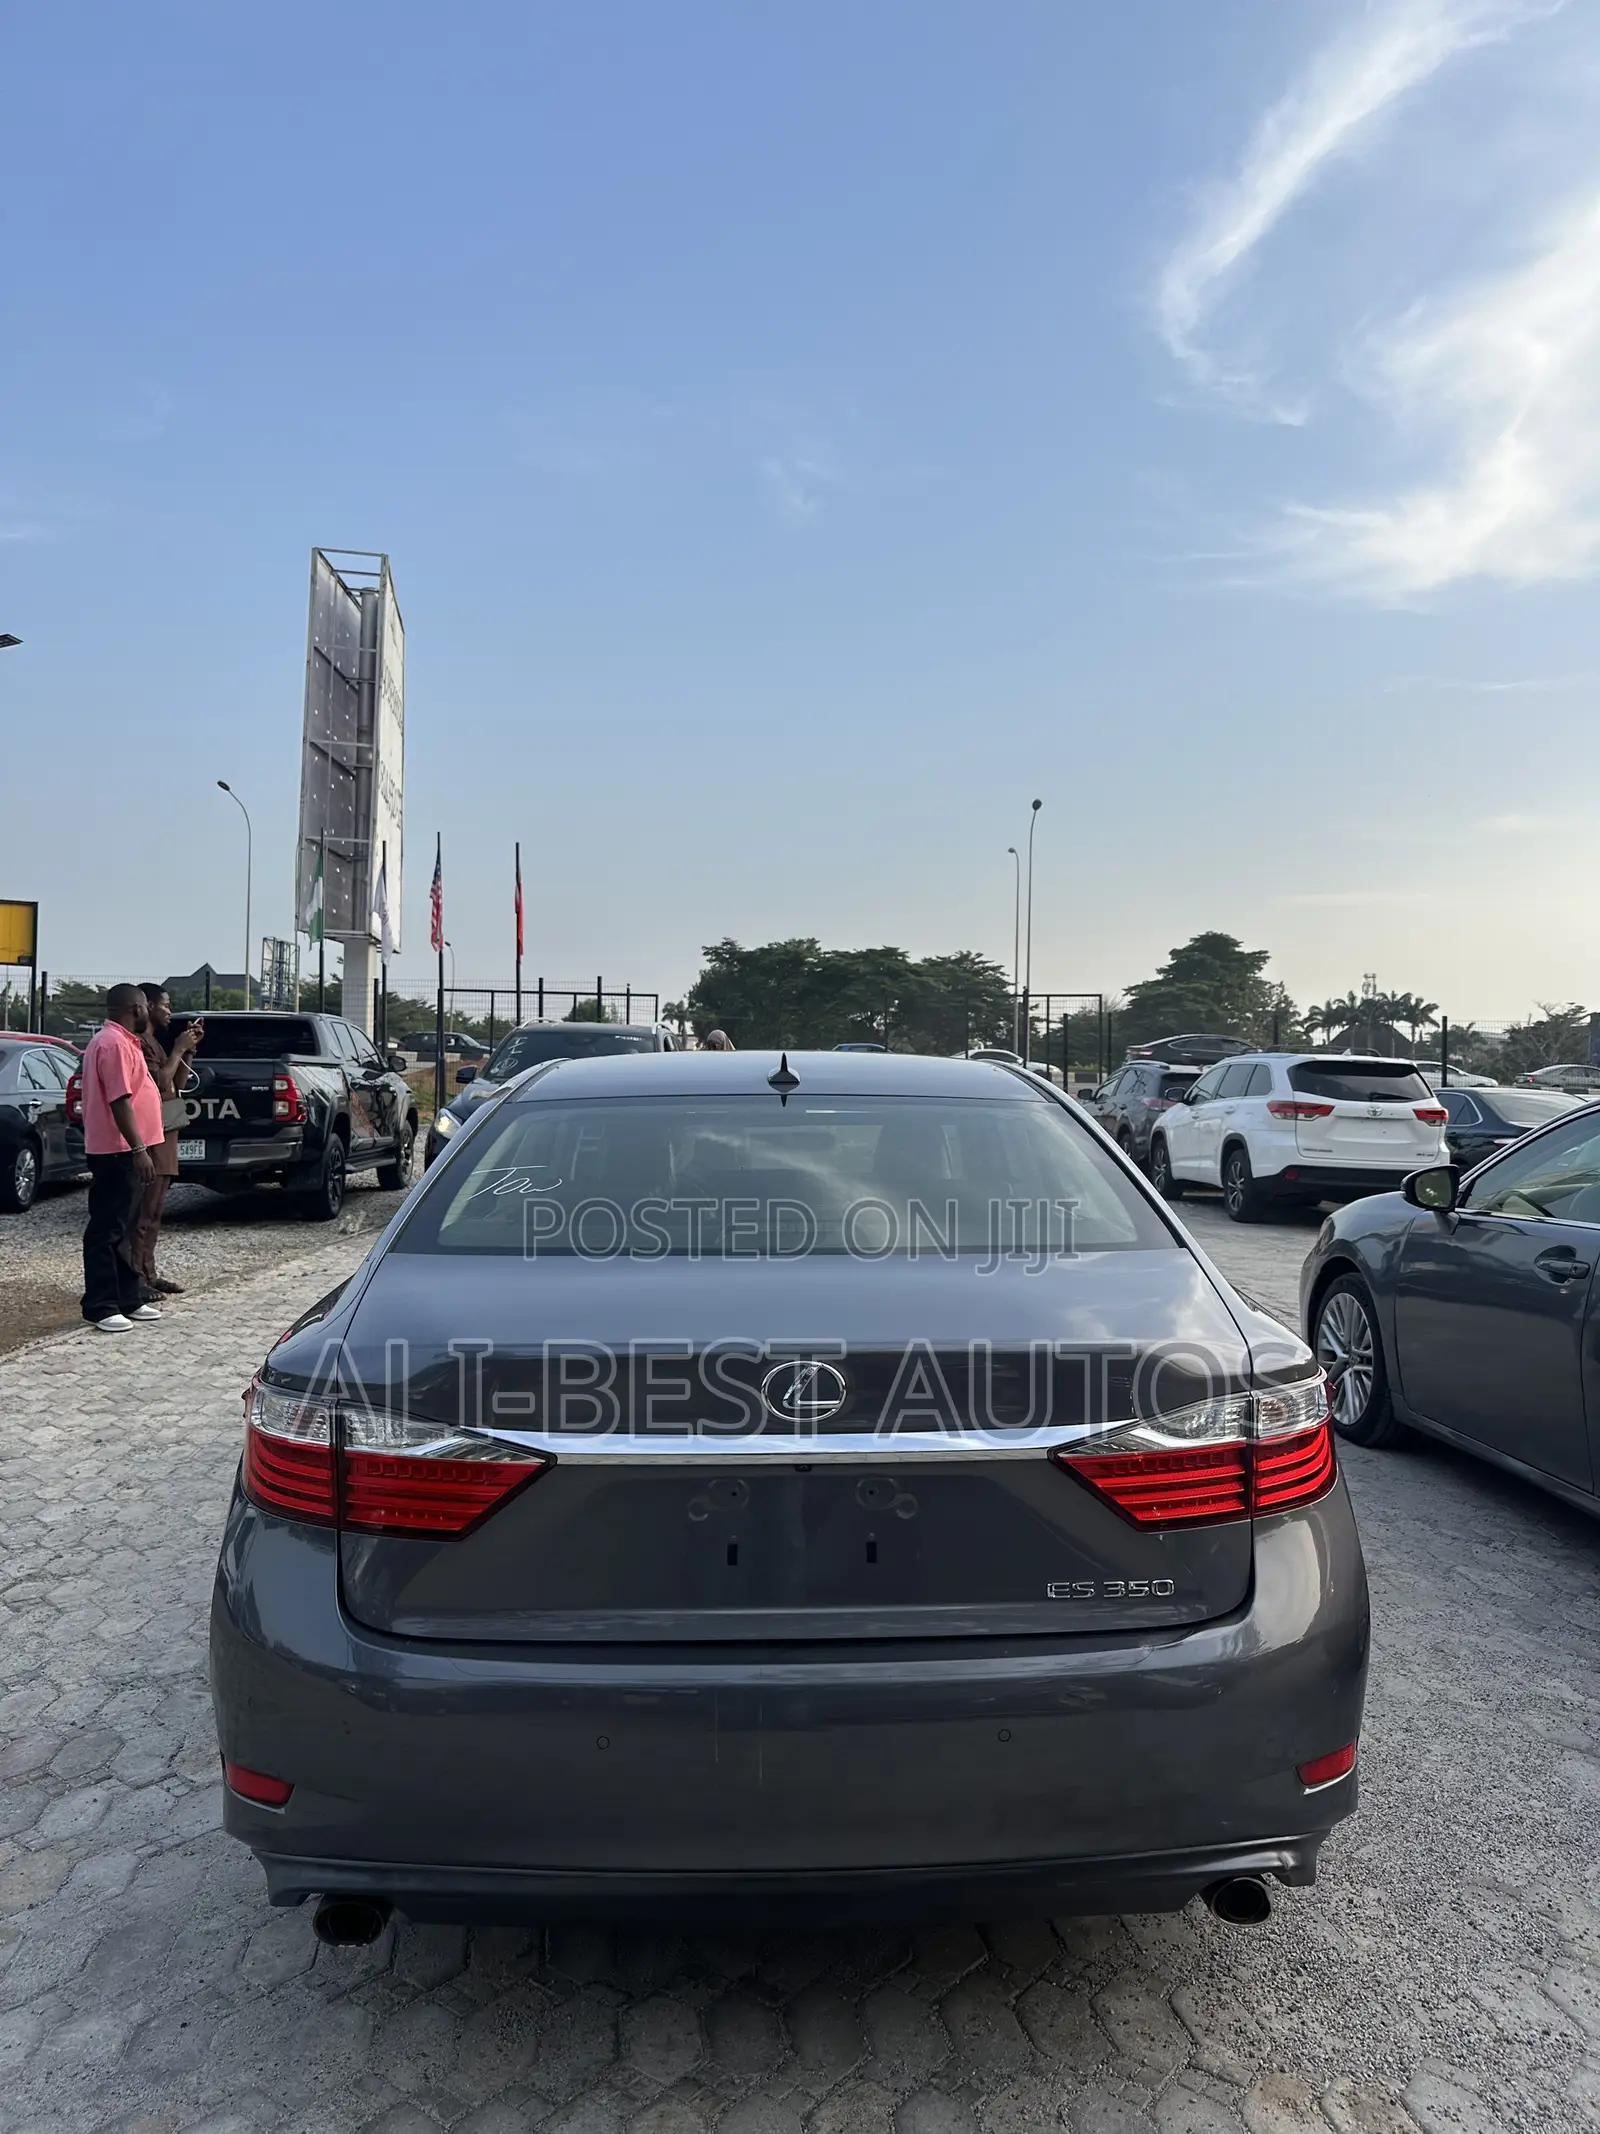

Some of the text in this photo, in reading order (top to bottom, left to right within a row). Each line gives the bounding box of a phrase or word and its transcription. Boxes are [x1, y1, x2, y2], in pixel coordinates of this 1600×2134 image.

[184, 1098, 241, 1120] OTA
[1047, 1579, 1175, 1598] ES 350
